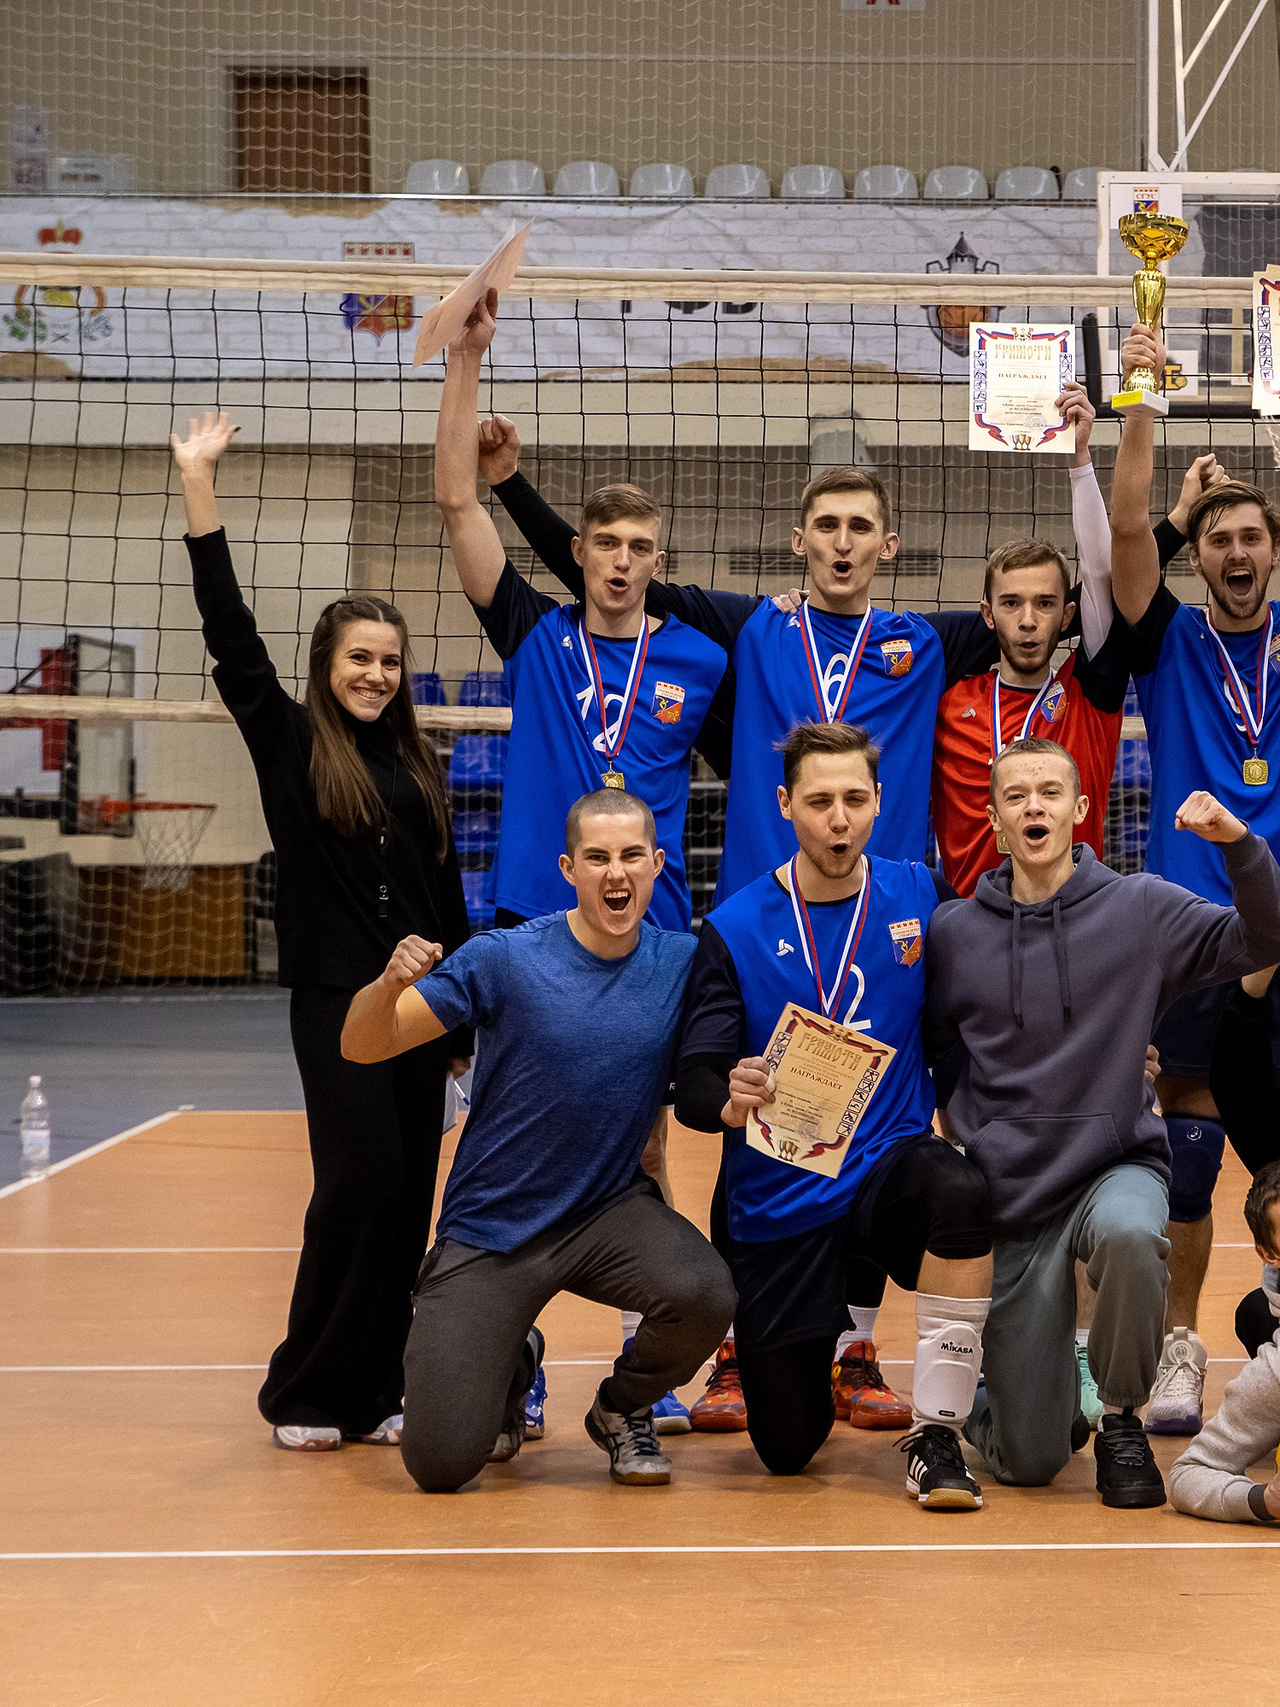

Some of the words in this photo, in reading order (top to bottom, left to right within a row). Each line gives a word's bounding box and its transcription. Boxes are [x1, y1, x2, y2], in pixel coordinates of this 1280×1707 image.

[994, 344, 1052, 361] ГРАМОТА
[843, 963, 872, 1031] 2
[797, 1032, 862, 1071] ГРАМОТА
[790, 1067, 844, 1091] НАГРАЖДАЕТ
